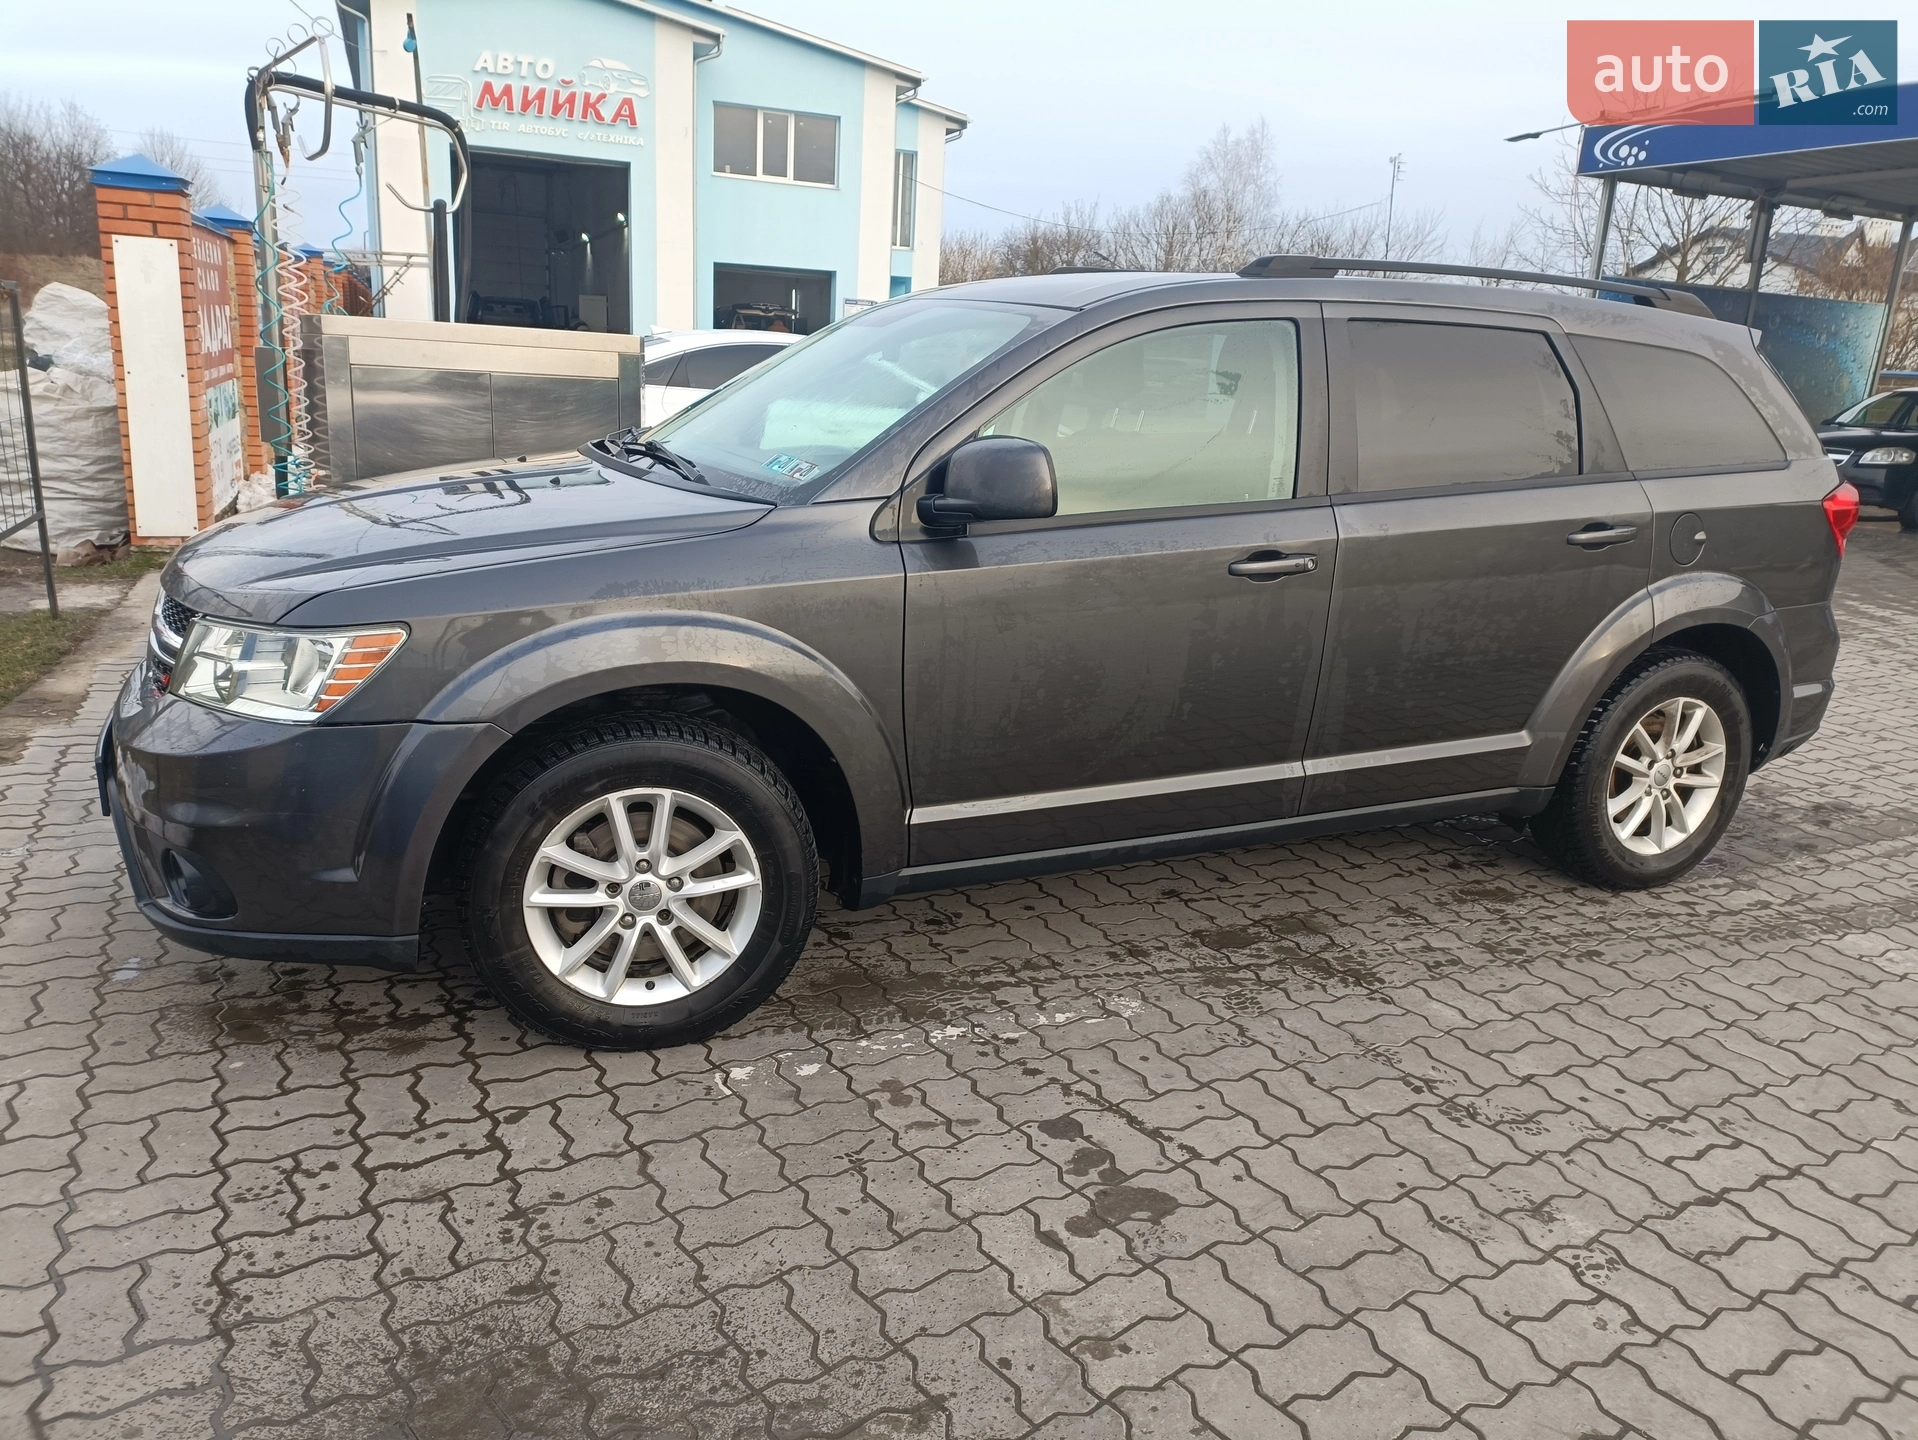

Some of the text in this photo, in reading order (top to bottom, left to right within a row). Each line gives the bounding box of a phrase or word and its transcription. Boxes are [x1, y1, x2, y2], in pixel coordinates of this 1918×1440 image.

[473, 50, 555, 80] АВТО
[474, 77, 639, 128] МИЙКА
[490, 120, 510, 131] TIR
[518, 123, 569, 138] АВТОБУС
